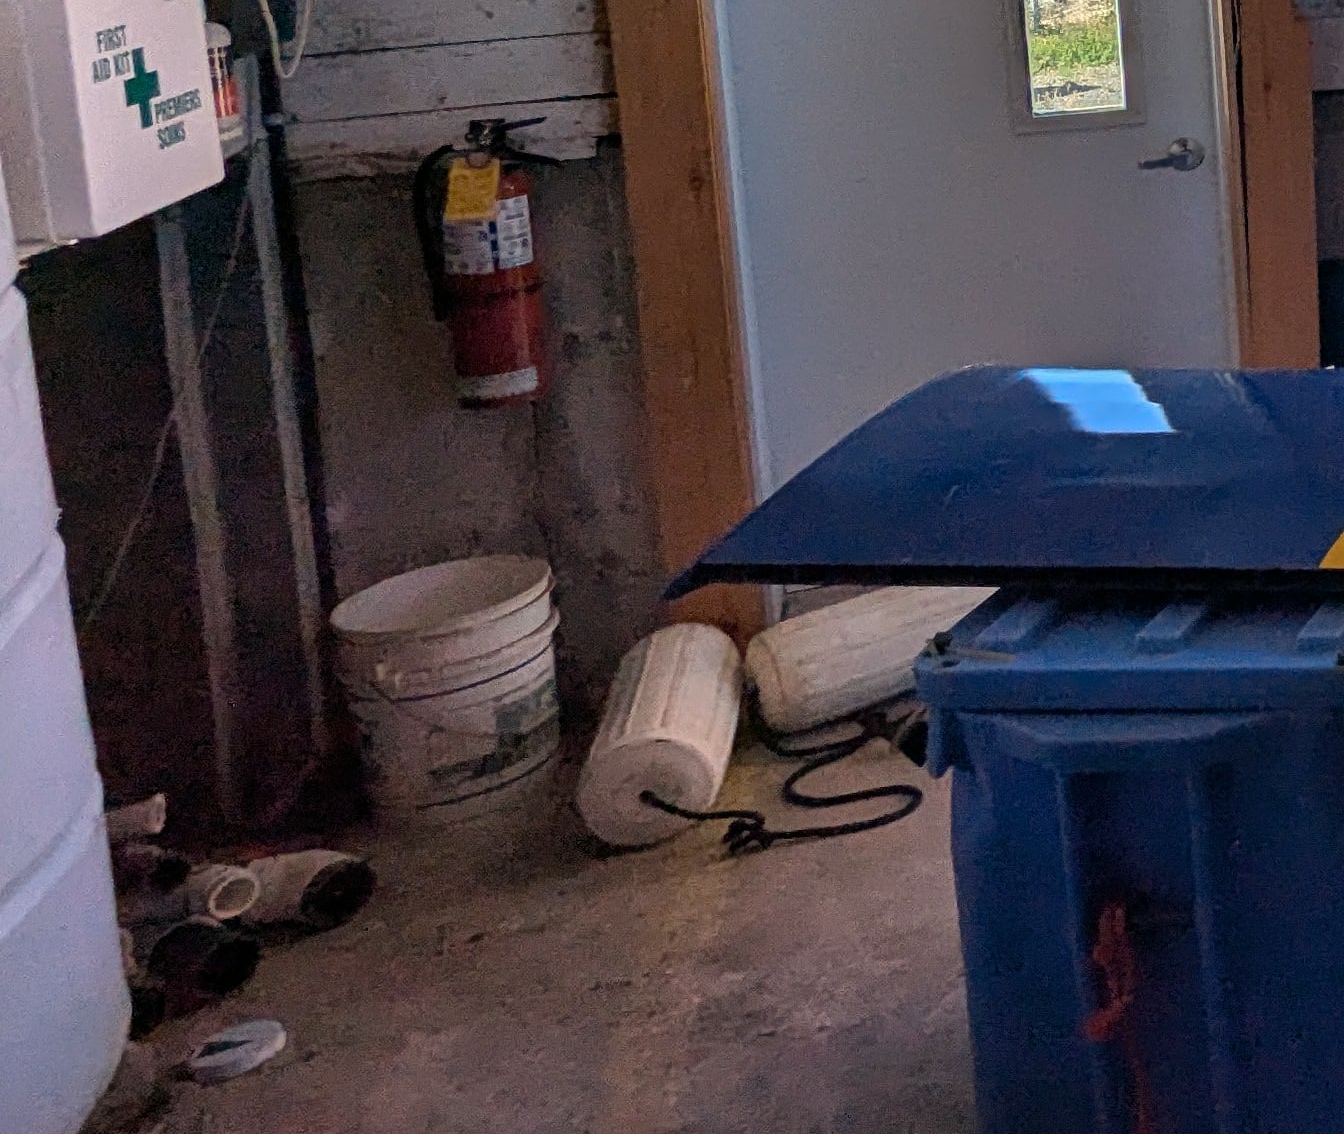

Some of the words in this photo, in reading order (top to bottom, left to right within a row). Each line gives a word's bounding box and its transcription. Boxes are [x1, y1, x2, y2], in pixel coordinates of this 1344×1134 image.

[96, 25, 126, 53] FIRST
[92, 57, 112, 83] AID
[113, 50, 130, 76] KIT
[154, 88, 201, 123] PREMIERS
